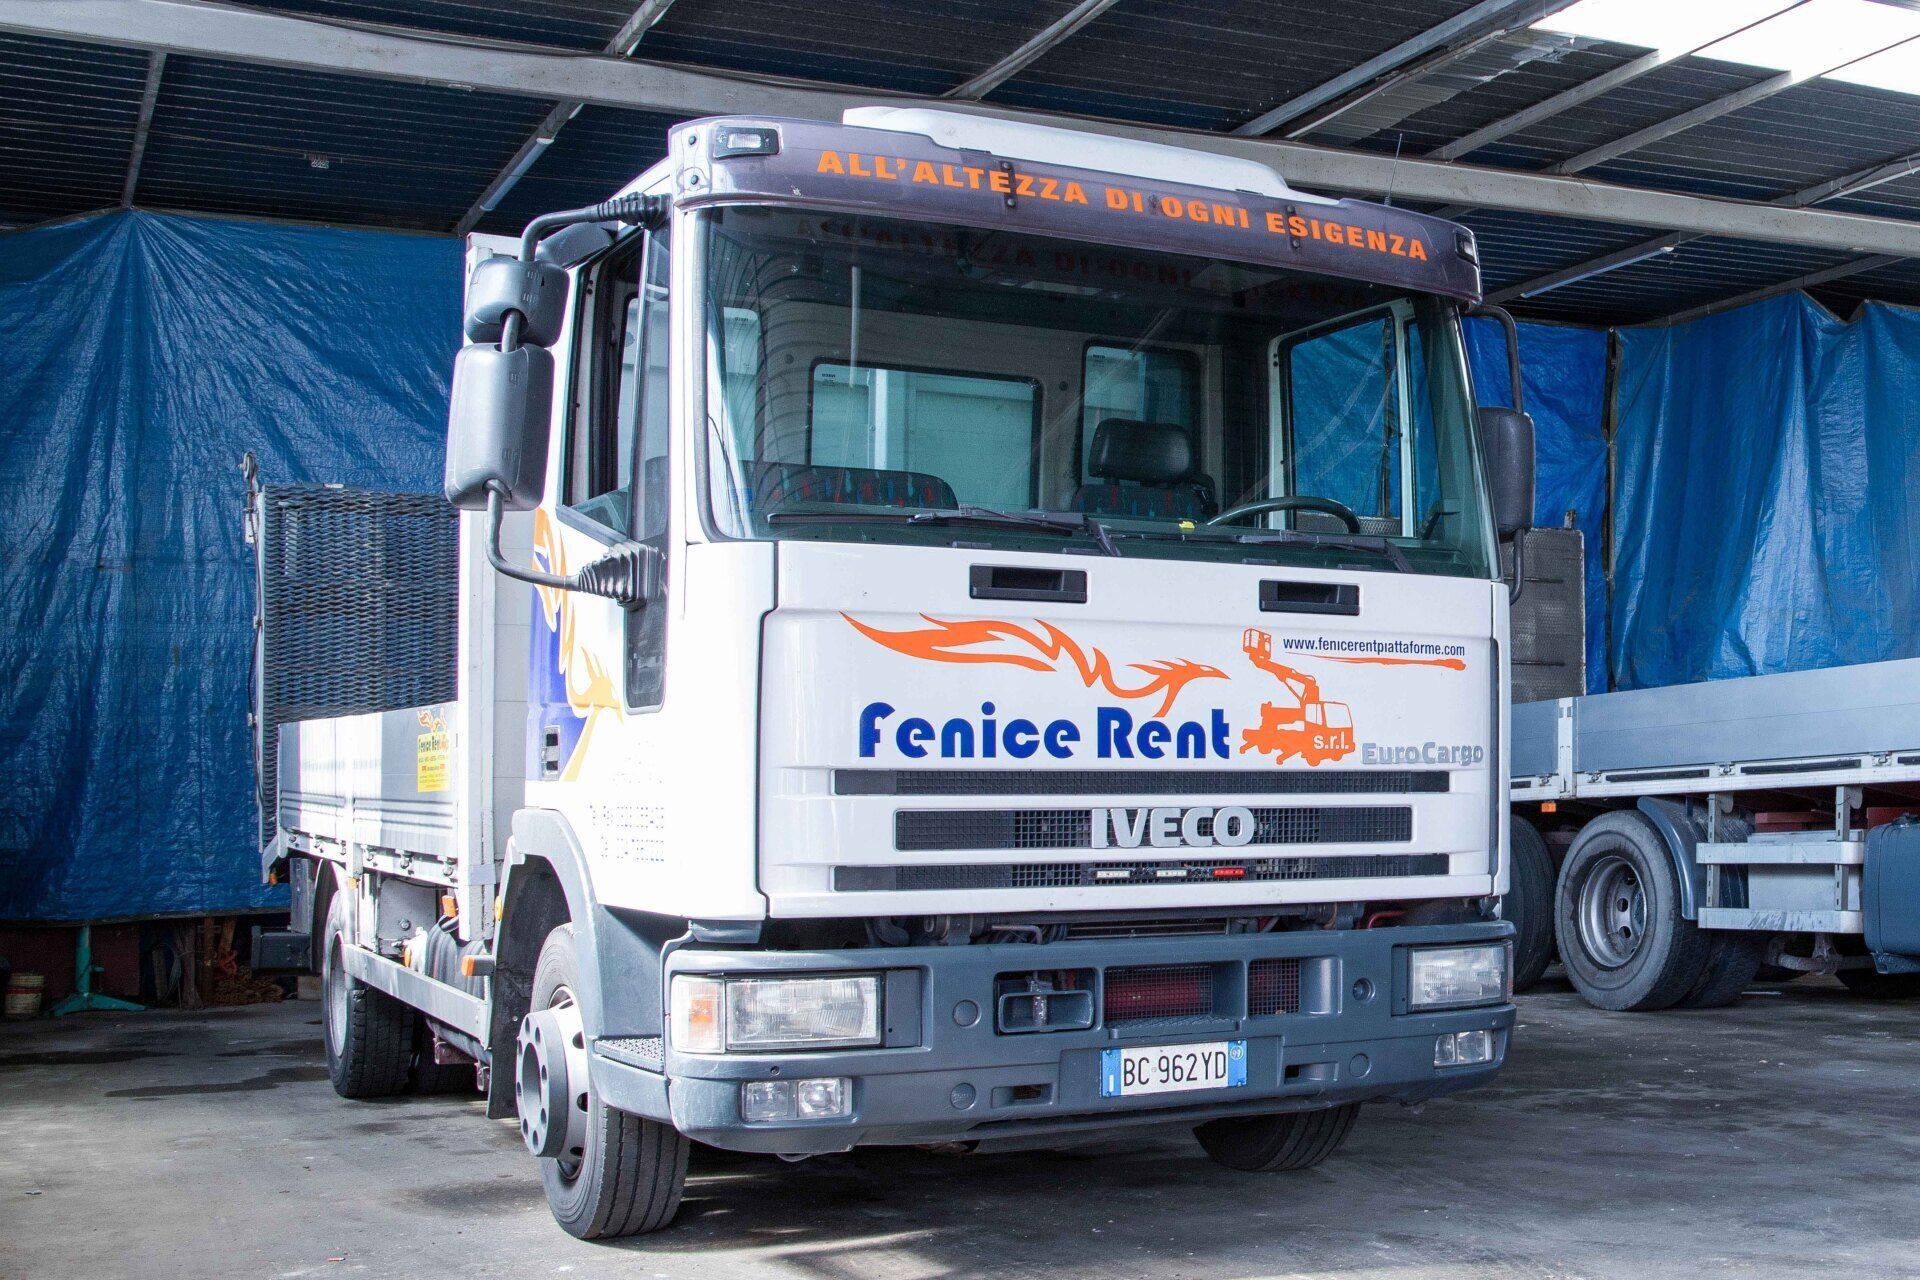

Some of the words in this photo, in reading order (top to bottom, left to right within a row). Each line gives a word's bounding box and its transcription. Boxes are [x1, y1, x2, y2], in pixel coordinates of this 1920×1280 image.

[817, 150, 1089, 204] ALL'ALTEZZA
[1105, 186, 1143, 212] DI
[1161, 197, 1250, 229] OGNI
[1265, 211, 1428, 261] ESIGENZA
[859, 701, 1081, 759] Fenice
[1097, 707, 1230, 759] Rent
[1313, 731, 1350, 750] s.r.l.
[1361, 741, 1483, 766] EuroCargo
[1091, 806, 1255, 849] IVECO
[1123, 1057, 1150, 1087] BC
[1158, 1051, 1227, 1084] 962YD
